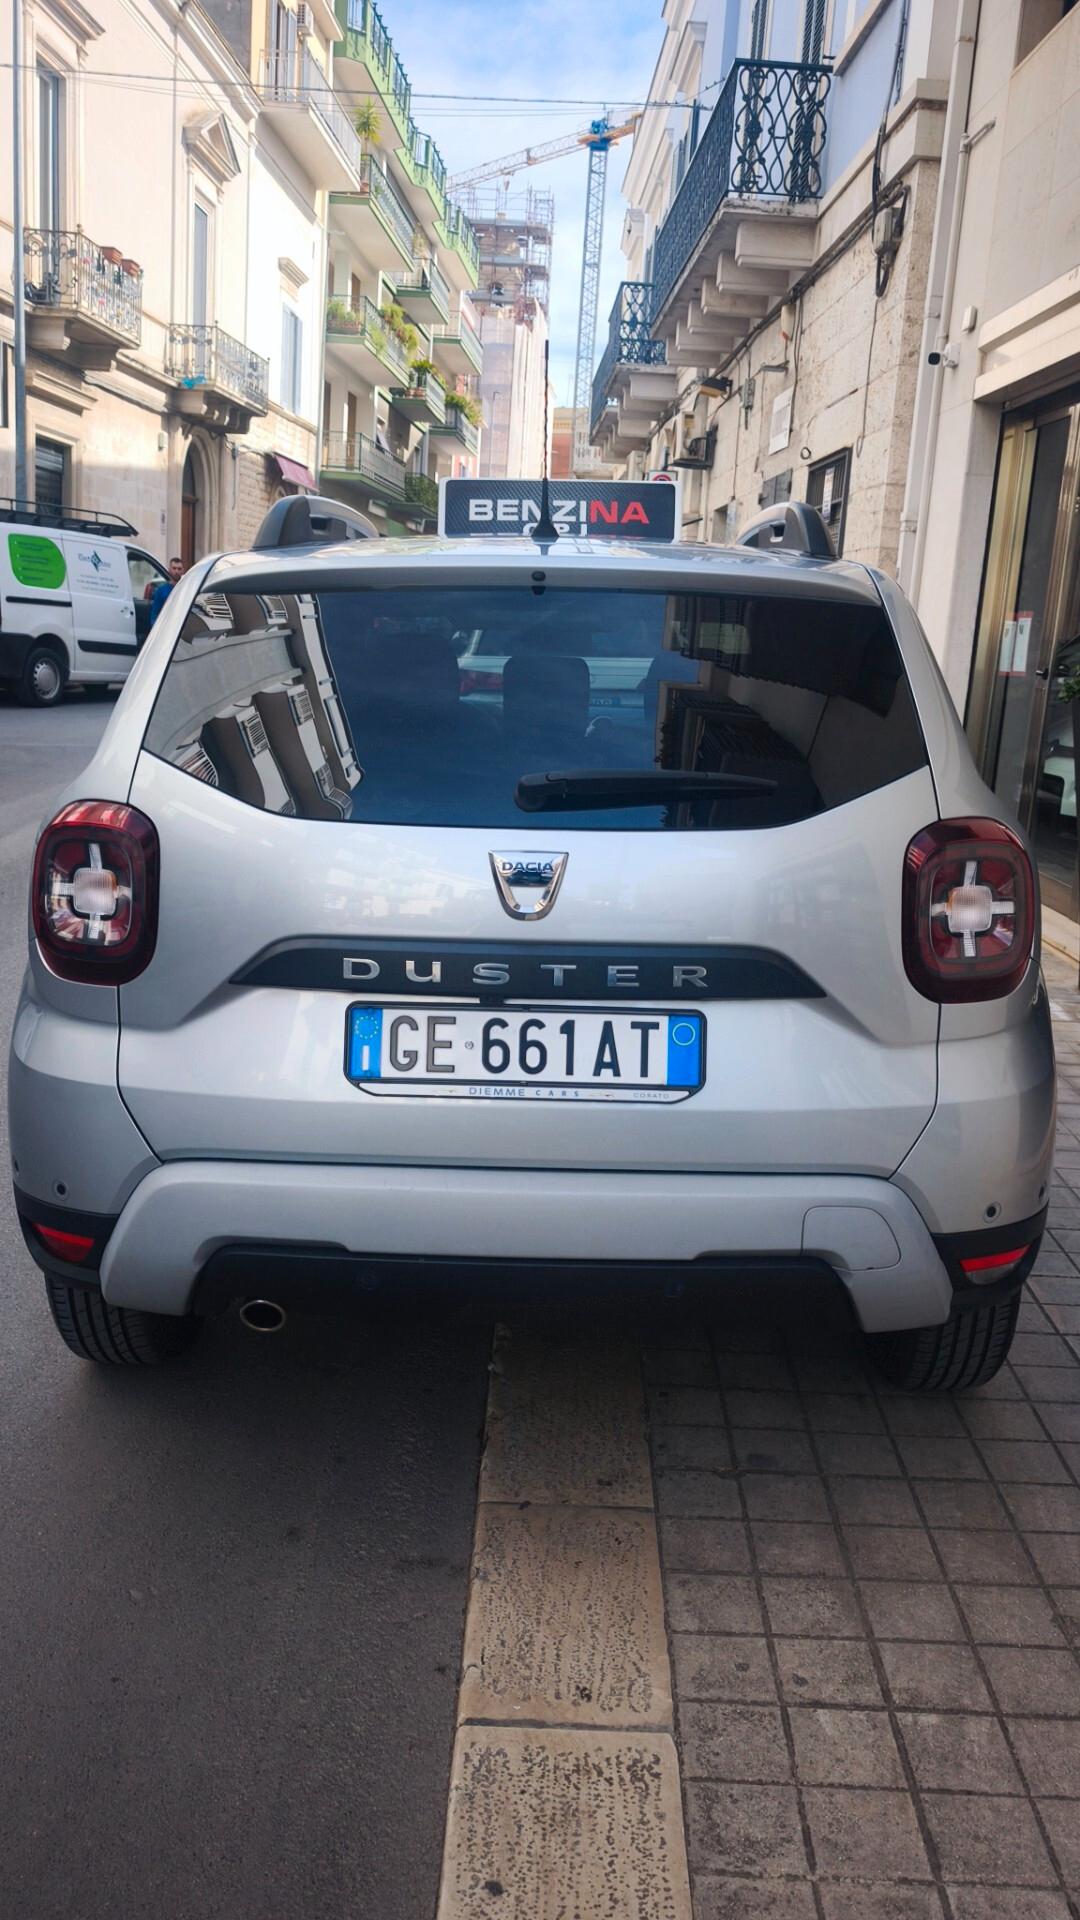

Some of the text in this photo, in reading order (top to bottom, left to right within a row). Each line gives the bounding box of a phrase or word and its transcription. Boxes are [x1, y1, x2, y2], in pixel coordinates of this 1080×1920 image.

[468, 499, 649, 523] BENZINA
[502, 861, 554, 872] DACIA
[342, 957, 709, 988] DUSTER
[389, 1015, 660, 1078] GE 661AT
[468, 1086, 670, 1100] DIEMME CARS CORATO
